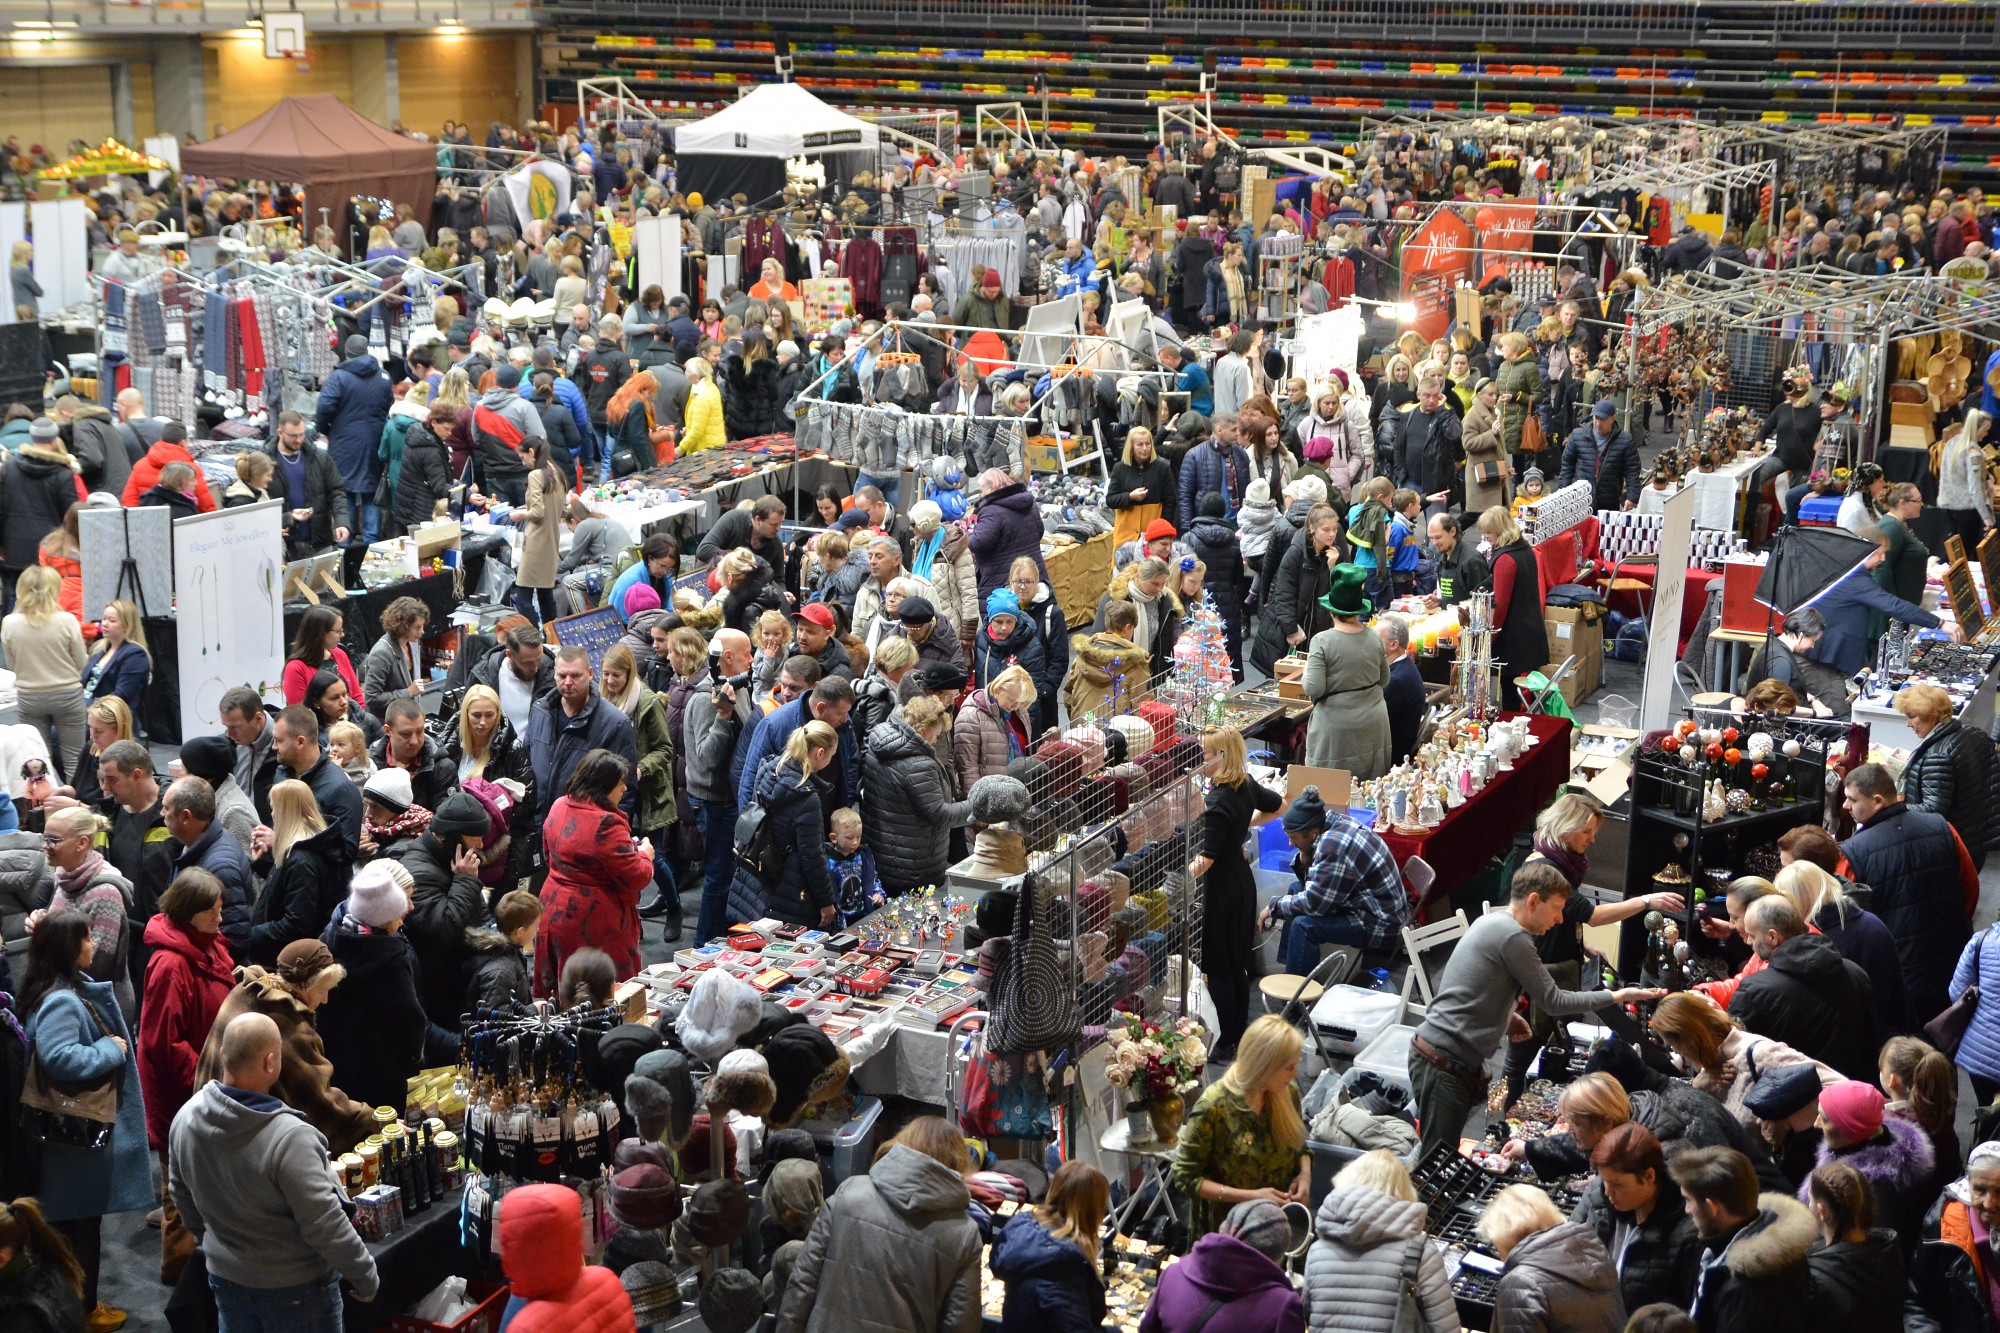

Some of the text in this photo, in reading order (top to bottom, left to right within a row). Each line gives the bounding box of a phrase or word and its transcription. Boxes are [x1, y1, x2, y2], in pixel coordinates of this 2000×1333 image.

[190, 528, 270, 553] Elegant Me Jewellery
